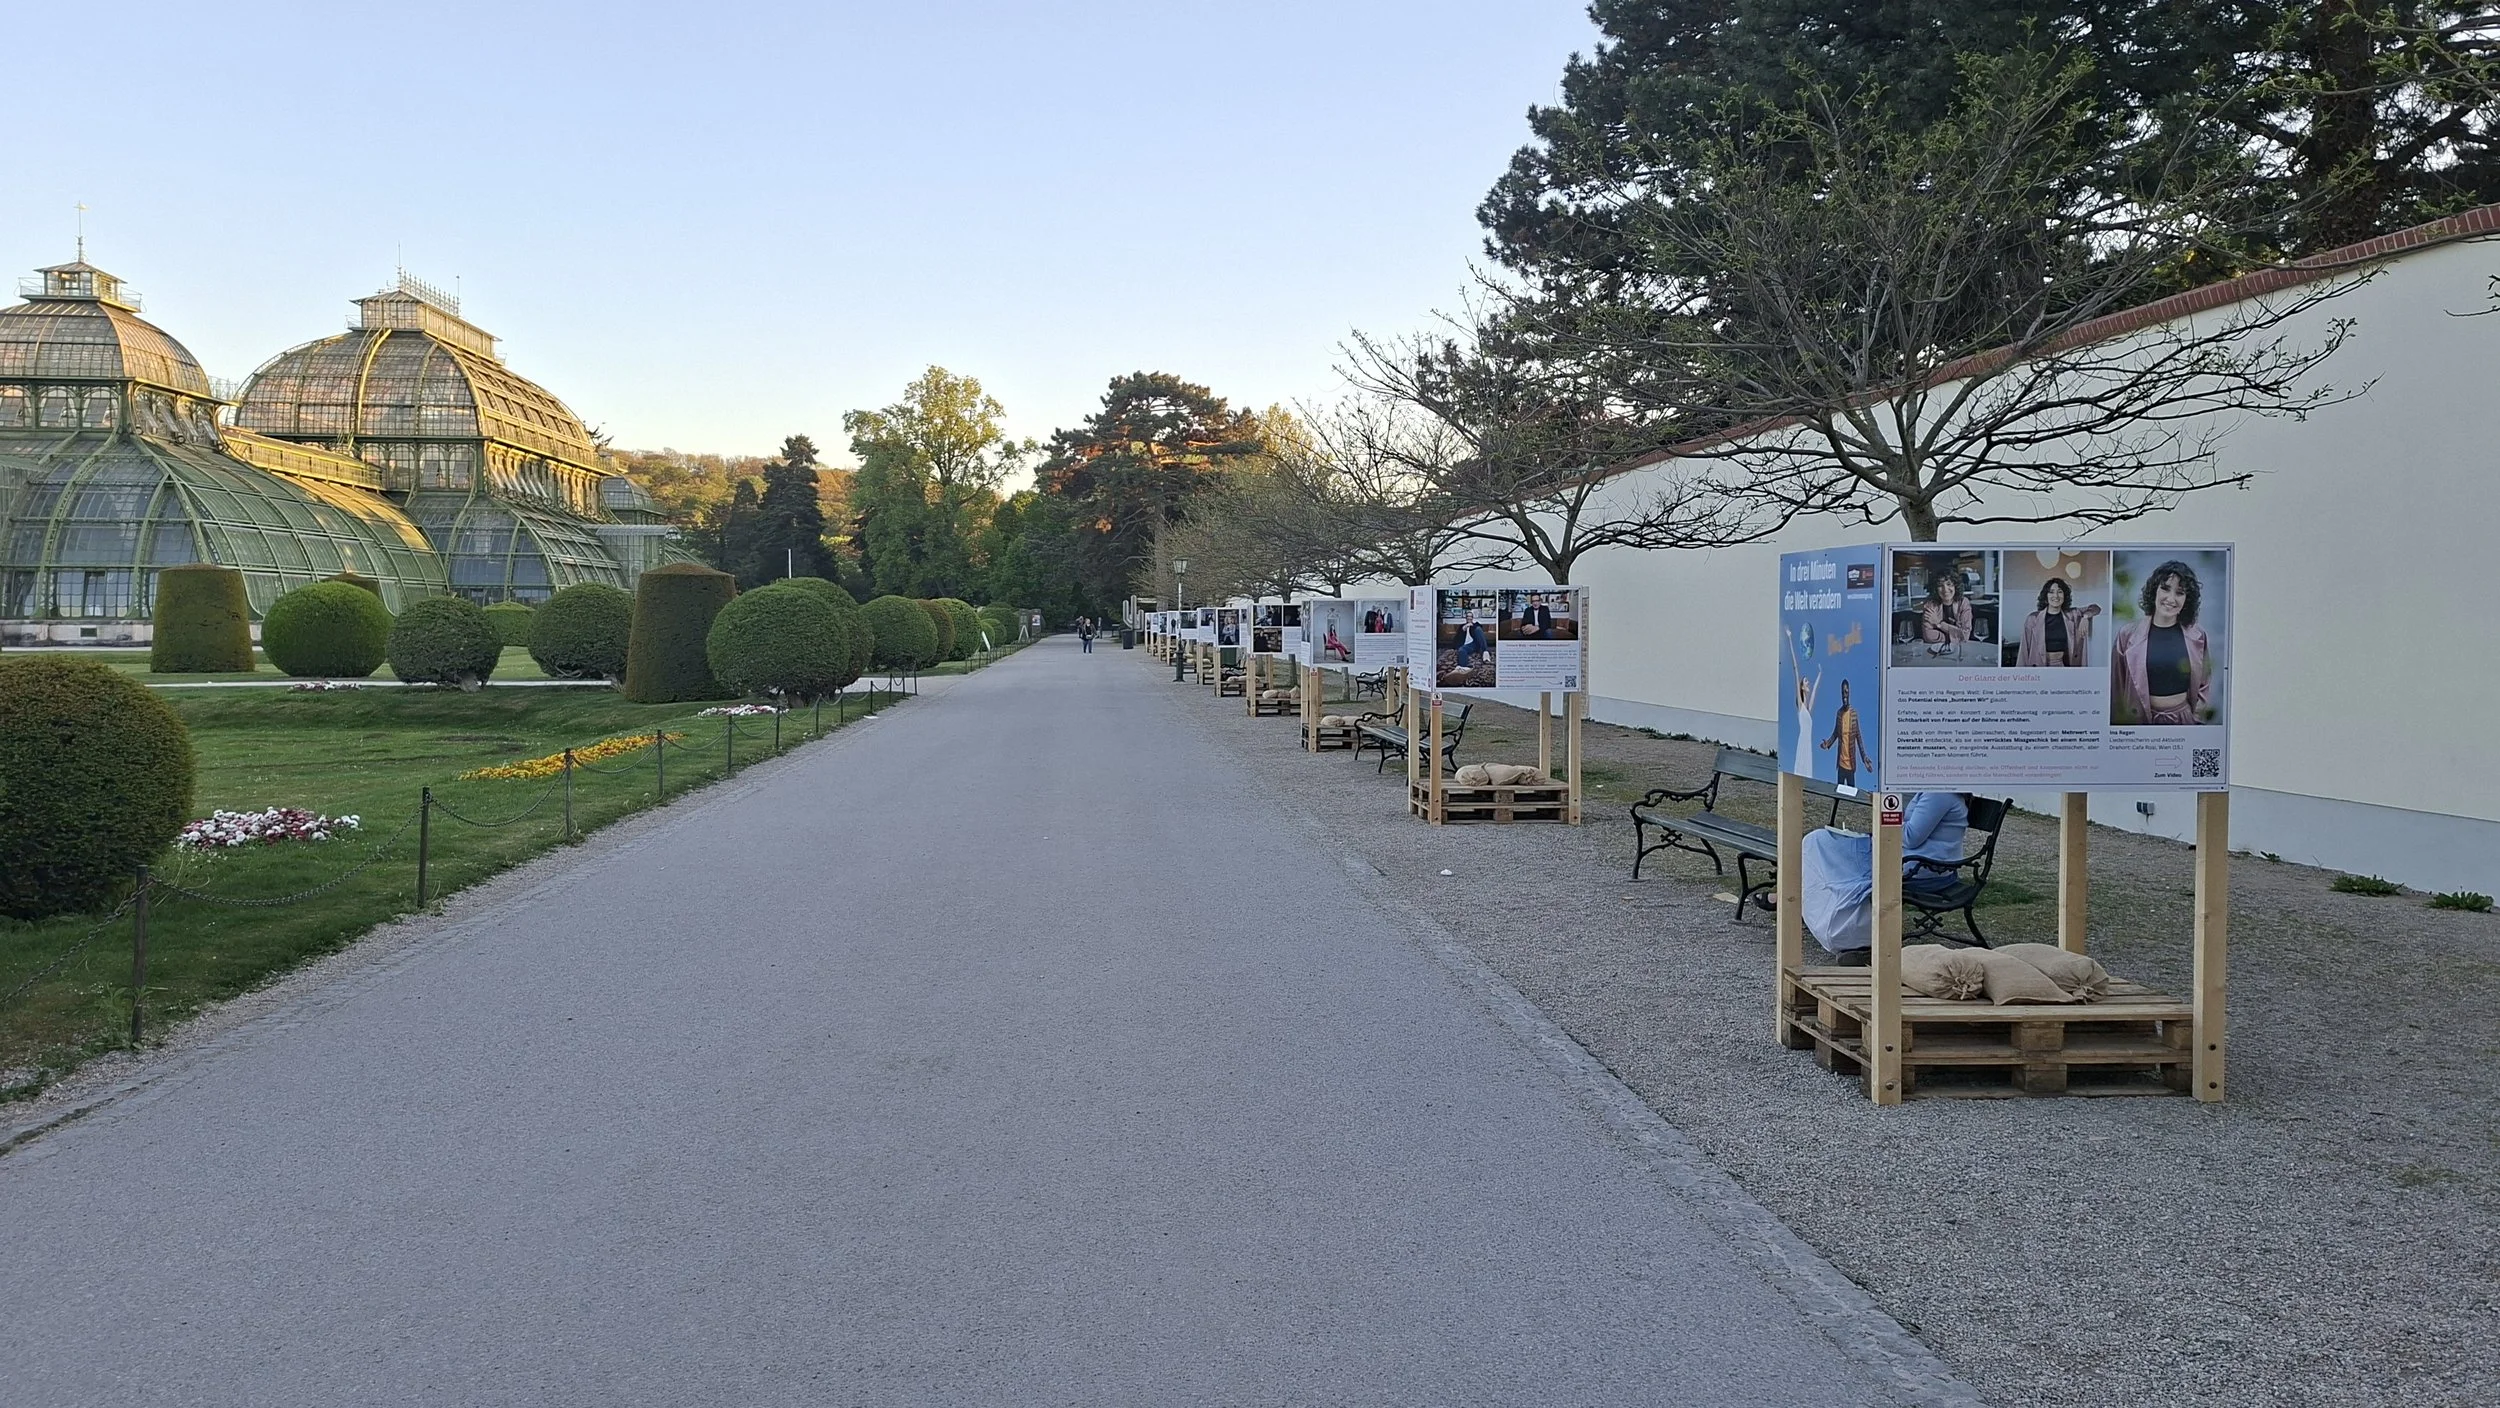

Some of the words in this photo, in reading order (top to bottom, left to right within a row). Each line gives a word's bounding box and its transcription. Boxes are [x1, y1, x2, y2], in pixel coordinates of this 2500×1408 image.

[1790, 563, 1796, 582] In
[1797, 561, 1809, 581] drei
[1810, 560, 1836, 581] Minuten
[1784, 592, 1794, 610] die
[1794, 590, 1808, 610] Welt
[1809, 589, 1841, 610] verändern
